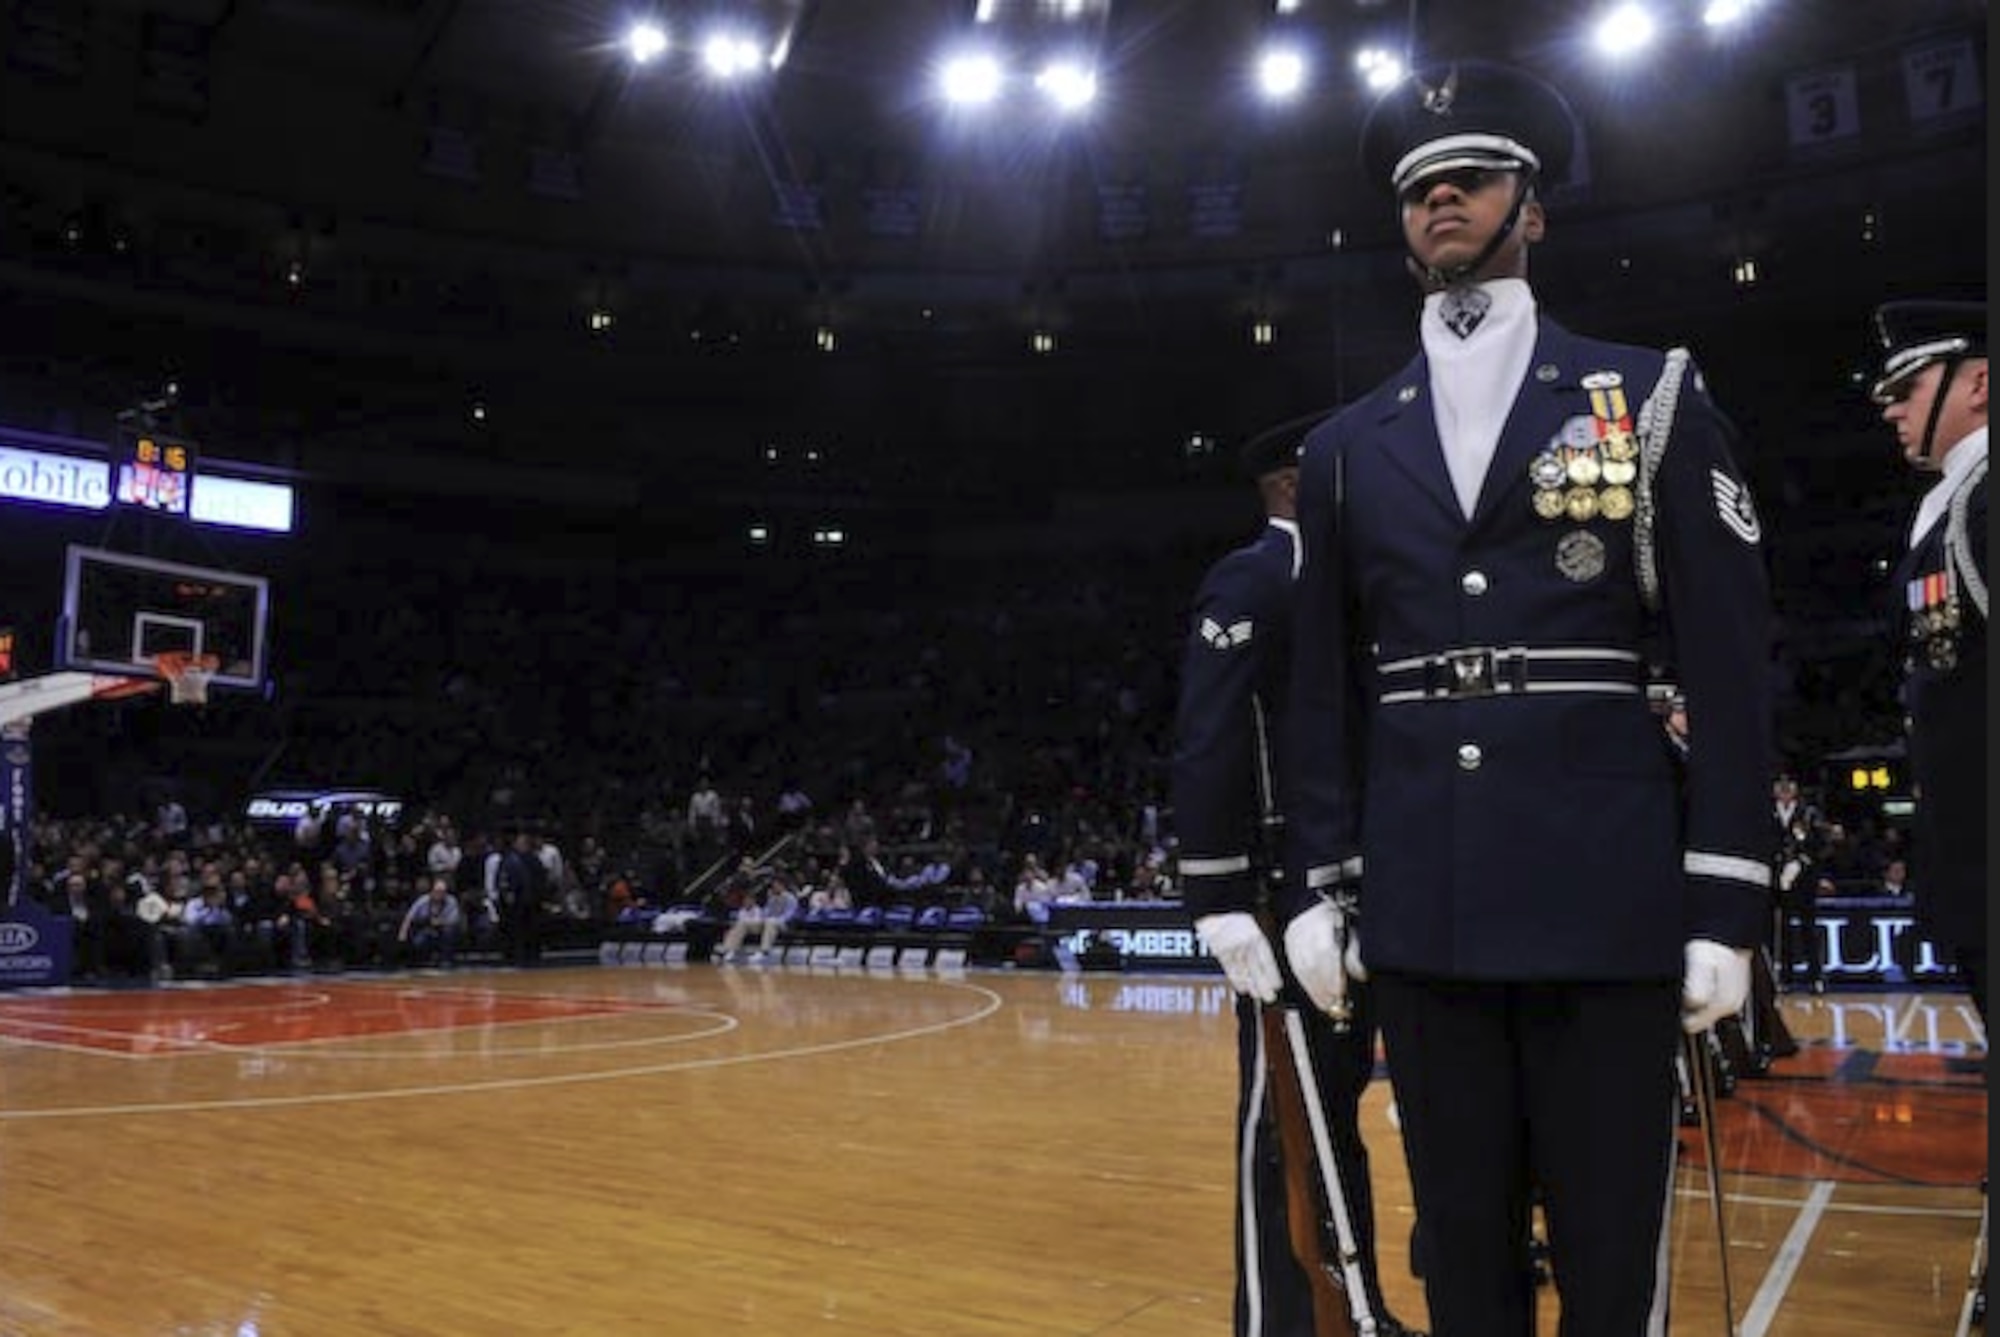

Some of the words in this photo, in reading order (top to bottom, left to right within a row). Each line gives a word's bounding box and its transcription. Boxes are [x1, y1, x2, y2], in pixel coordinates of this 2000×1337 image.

[1925, 67, 1955, 109] 7
[1808, 93, 1837, 135] 3
[0, 455, 103, 502] obile
